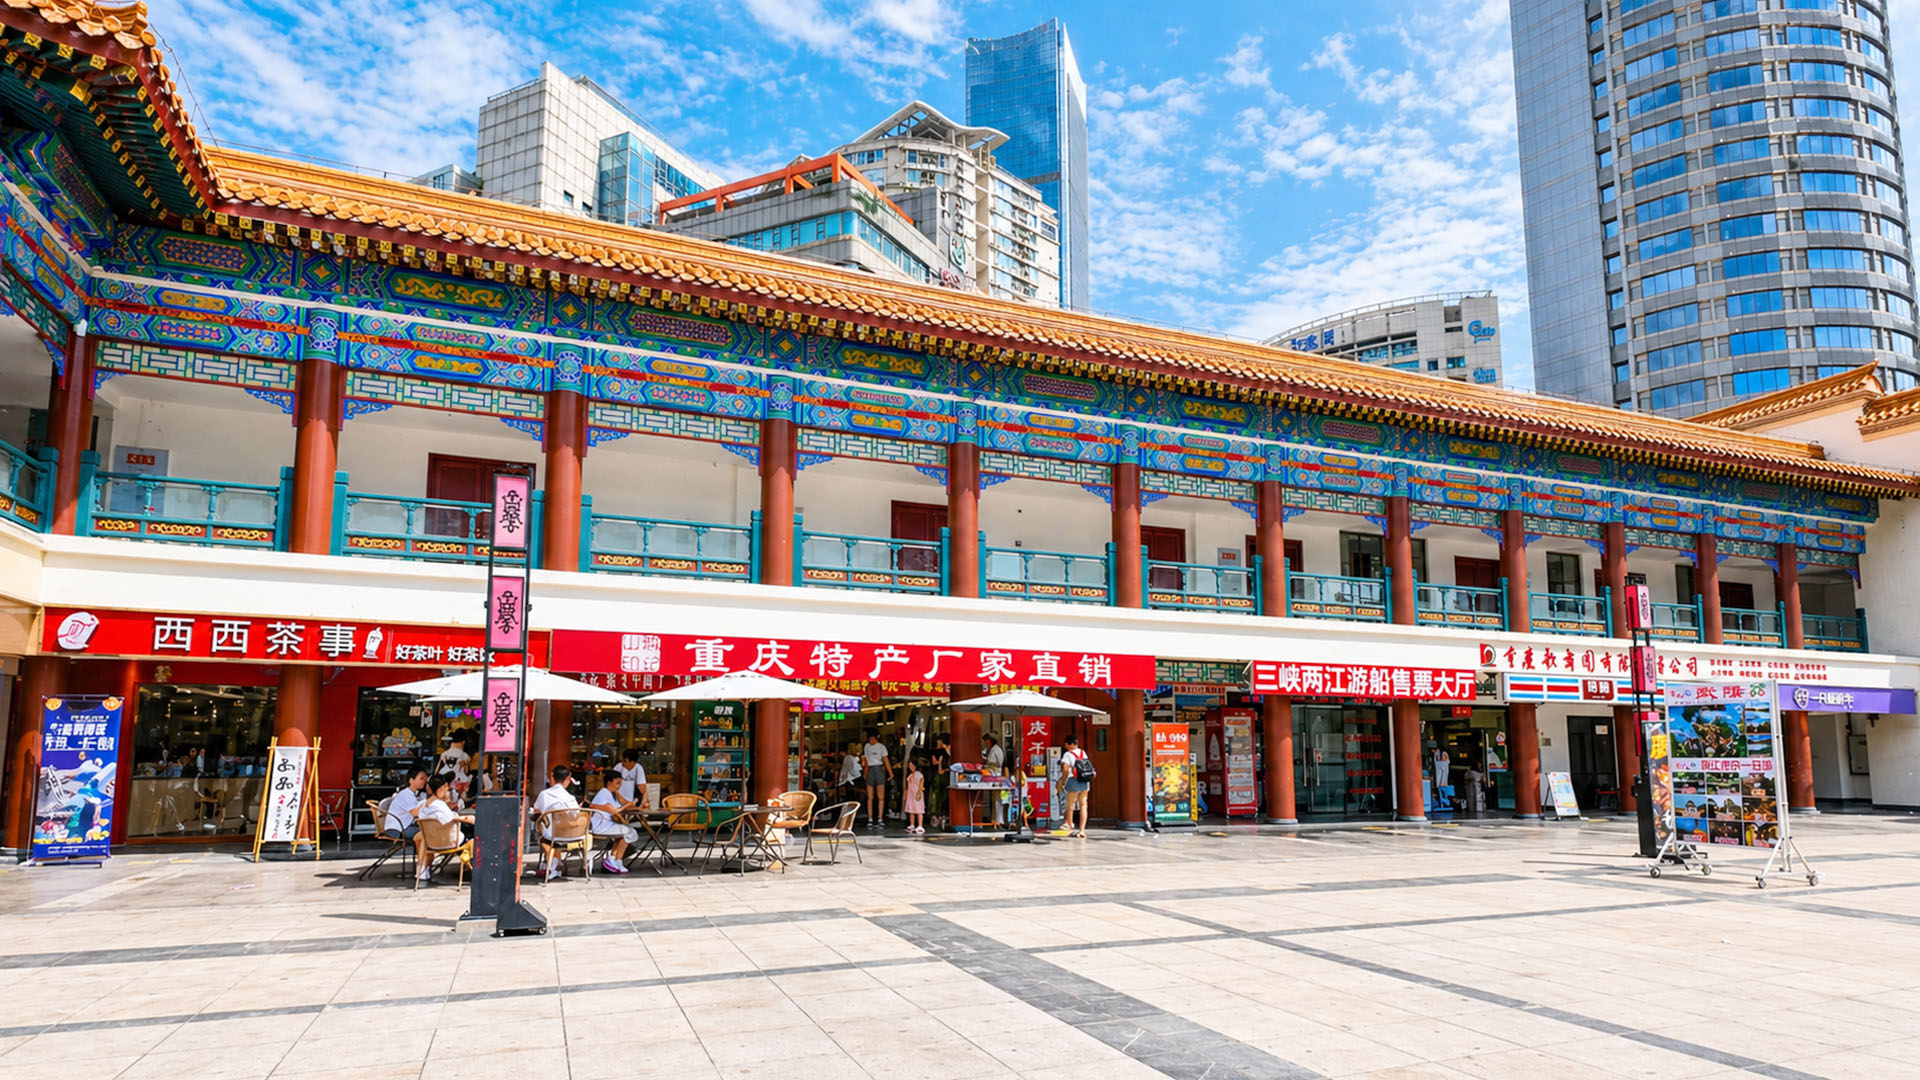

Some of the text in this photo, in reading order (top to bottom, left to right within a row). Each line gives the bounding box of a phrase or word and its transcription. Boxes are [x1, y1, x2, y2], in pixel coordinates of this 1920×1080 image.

[153, 616, 356, 660] 西西茶事
[395, 644, 443, 661] 好茶叶
[685, 638, 1112, 686] 重庆特产厂家直销
[1255, 663, 1475, 698] 三峡两江游船售票大厅
